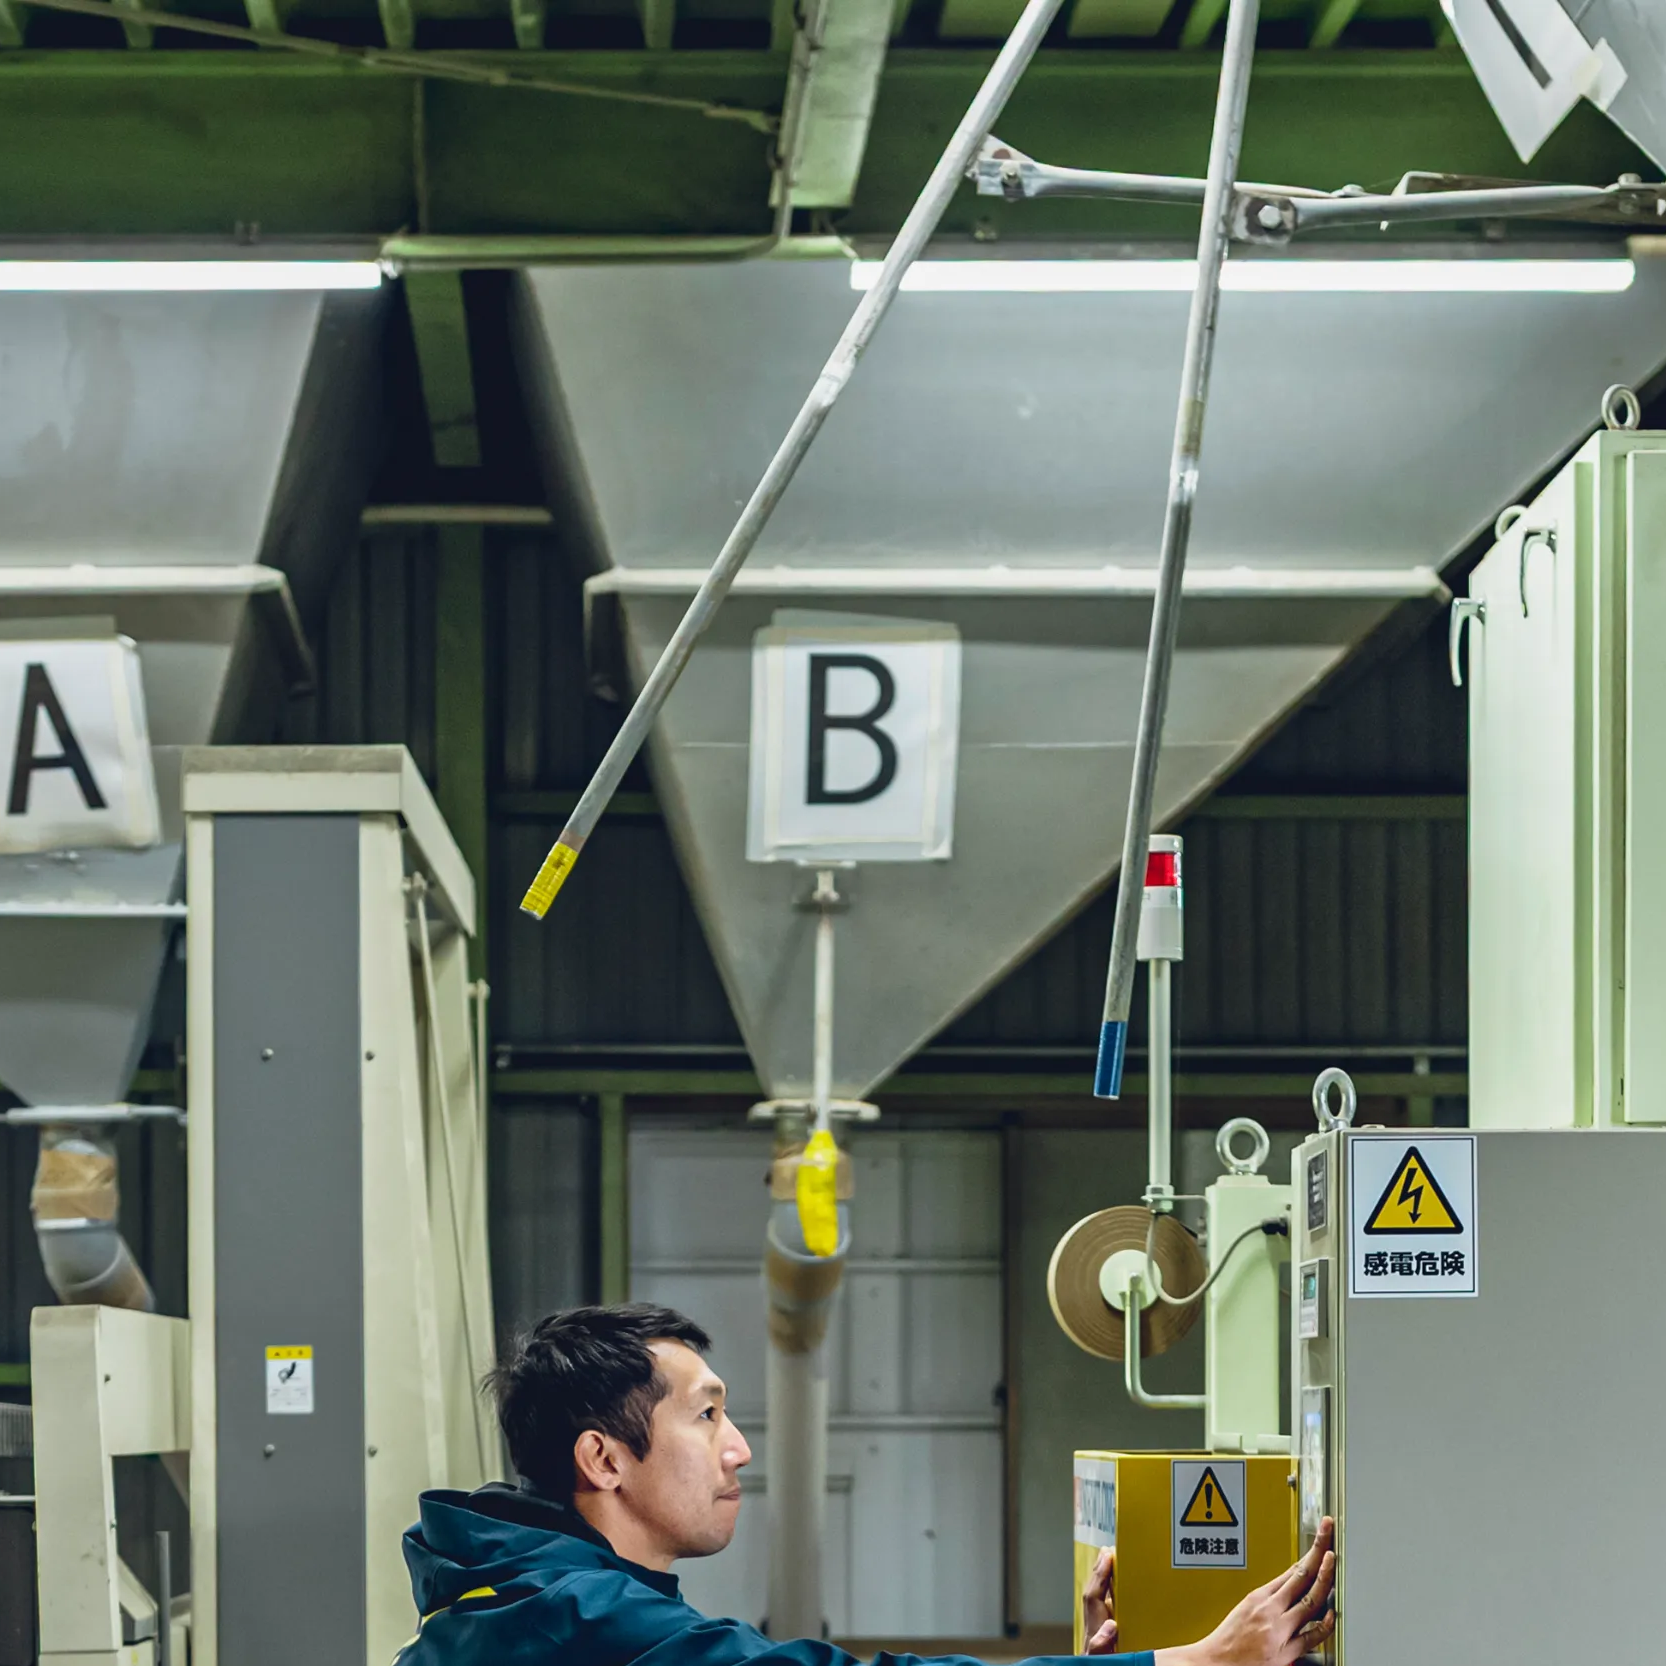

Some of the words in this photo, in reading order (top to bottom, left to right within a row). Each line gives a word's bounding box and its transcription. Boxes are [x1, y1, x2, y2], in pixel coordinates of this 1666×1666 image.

[6, 662, 108, 816] A
[804, 652, 898, 805] B
[1363, 1250, 1466, 1277] 感電危険
[1179, 1537, 1240, 1556] 危険注意
